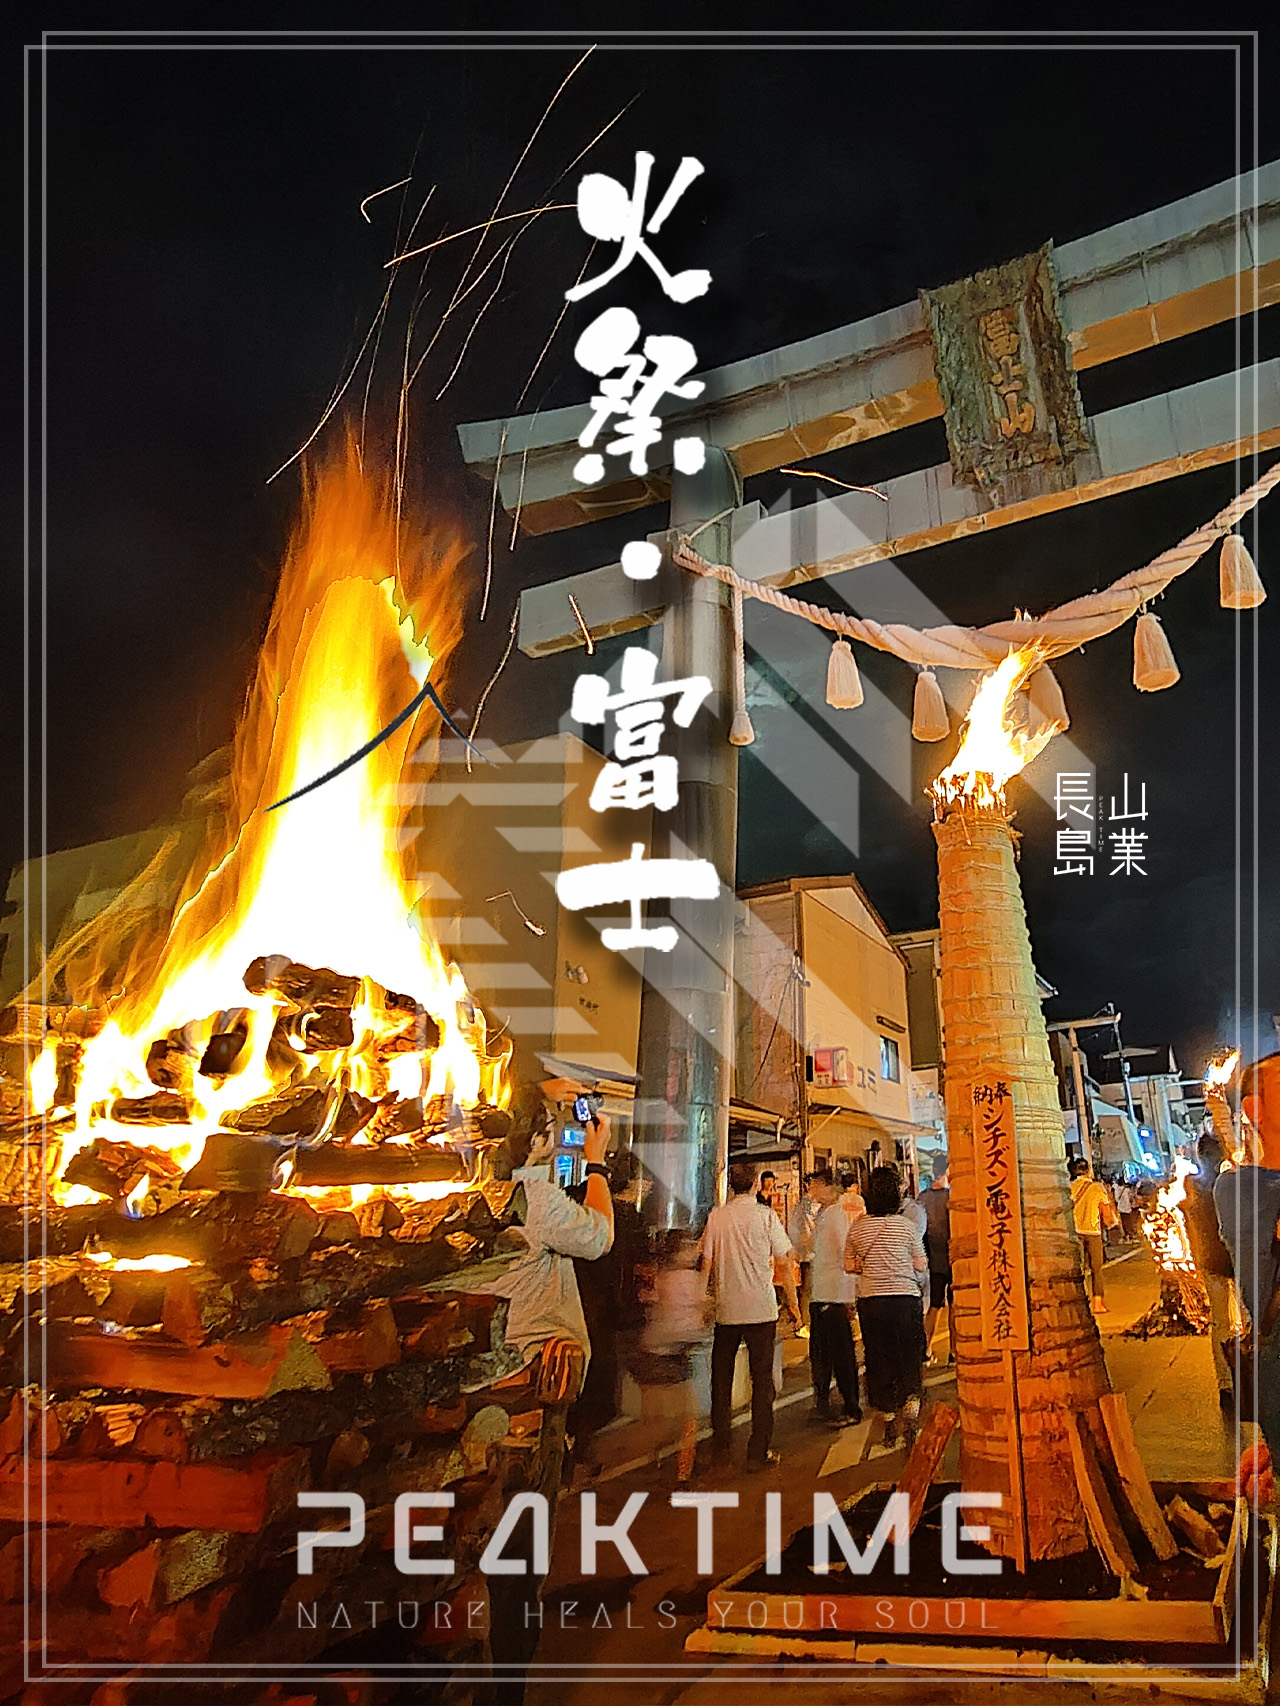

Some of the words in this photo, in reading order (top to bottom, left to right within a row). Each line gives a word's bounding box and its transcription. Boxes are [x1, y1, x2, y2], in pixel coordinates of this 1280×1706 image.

[982, 1106, 1018, 1342] シチズン電子株式会社
